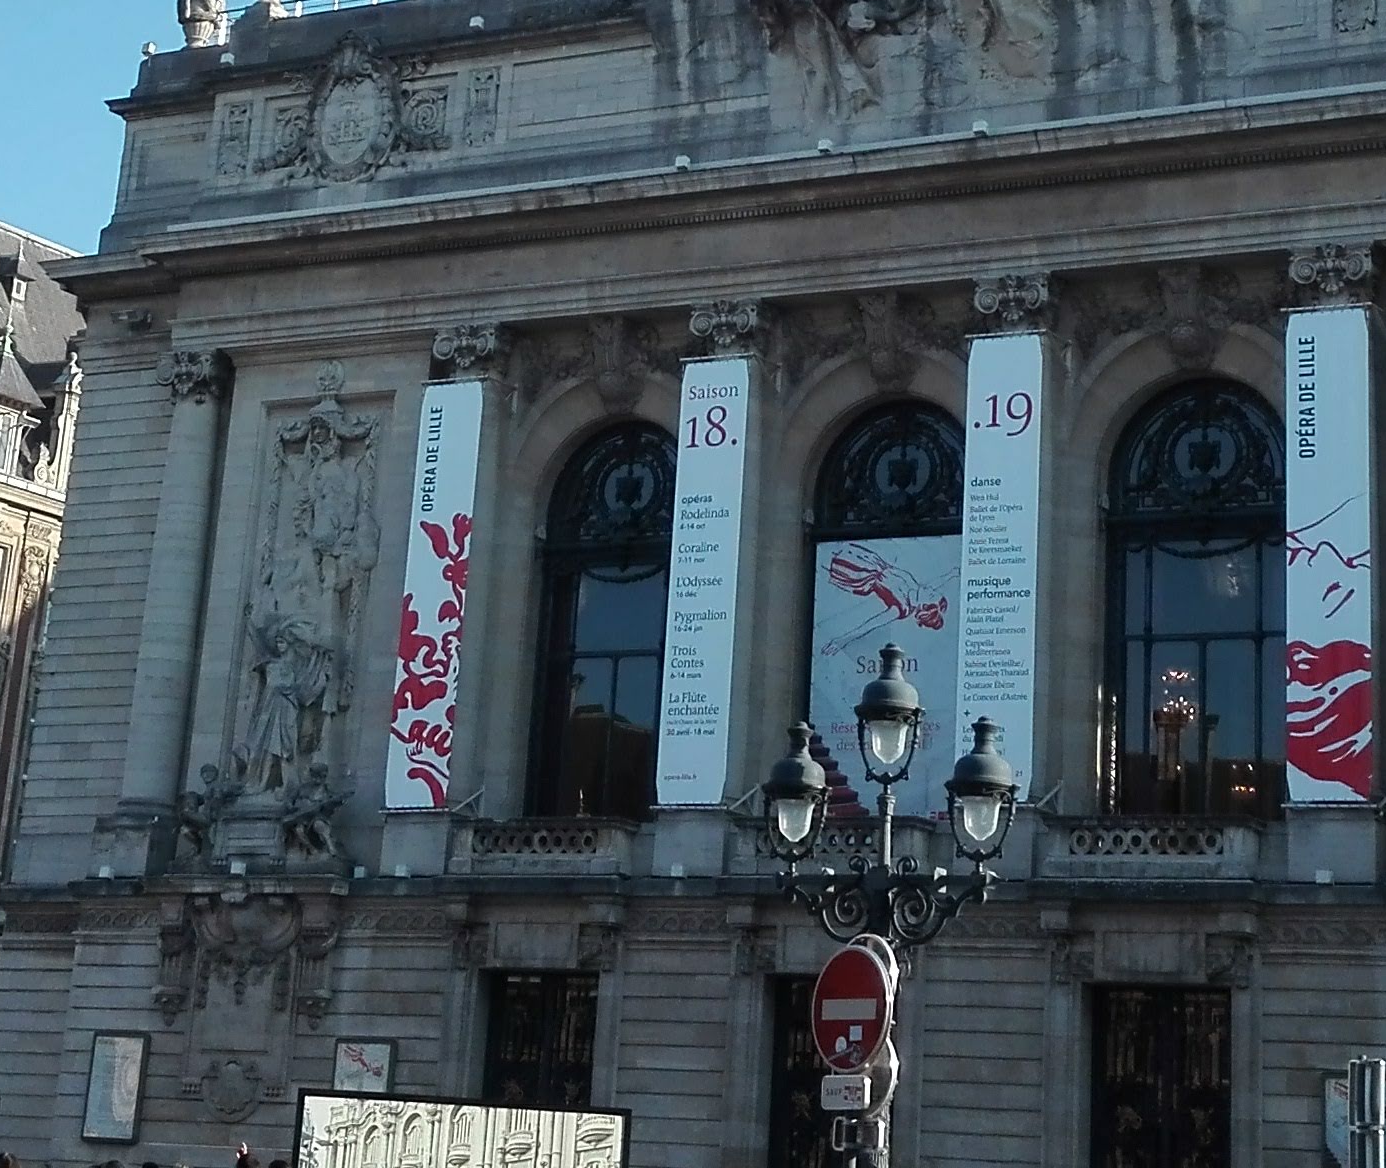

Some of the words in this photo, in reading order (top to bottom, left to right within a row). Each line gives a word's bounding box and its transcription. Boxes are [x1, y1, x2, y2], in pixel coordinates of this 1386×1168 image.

[1298, 336, 1315, 377] LILLE
[688, 384, 739, 400] Saison
[1298, 382, 1315, 402] DE
[428, 405, 443, 441] LILLE
[1295, 407, 1316, 459] OPÉRA
[426, 445, 439, 463] DE
[970, 477, 1001, 487] danse
[420, 467, 437, 512] OPÉRA
[681, 494, 713, 507] opéras
[681, 507, 730, 520] Rodelinda
[678, 541, 719, 554] Coraline
[967, 576, 1011, 588] musique
[967, 588, 1031, 602] performance
[674, 609, 727, 624] Pygmalion
[672, 645, 697, 656] Trois
[671, 657, 704, 669] Contes
[668, 692, 680, 704] La
[681, 691, 707, 704] Flûte
[667, 703, 720, 716] enchantée
